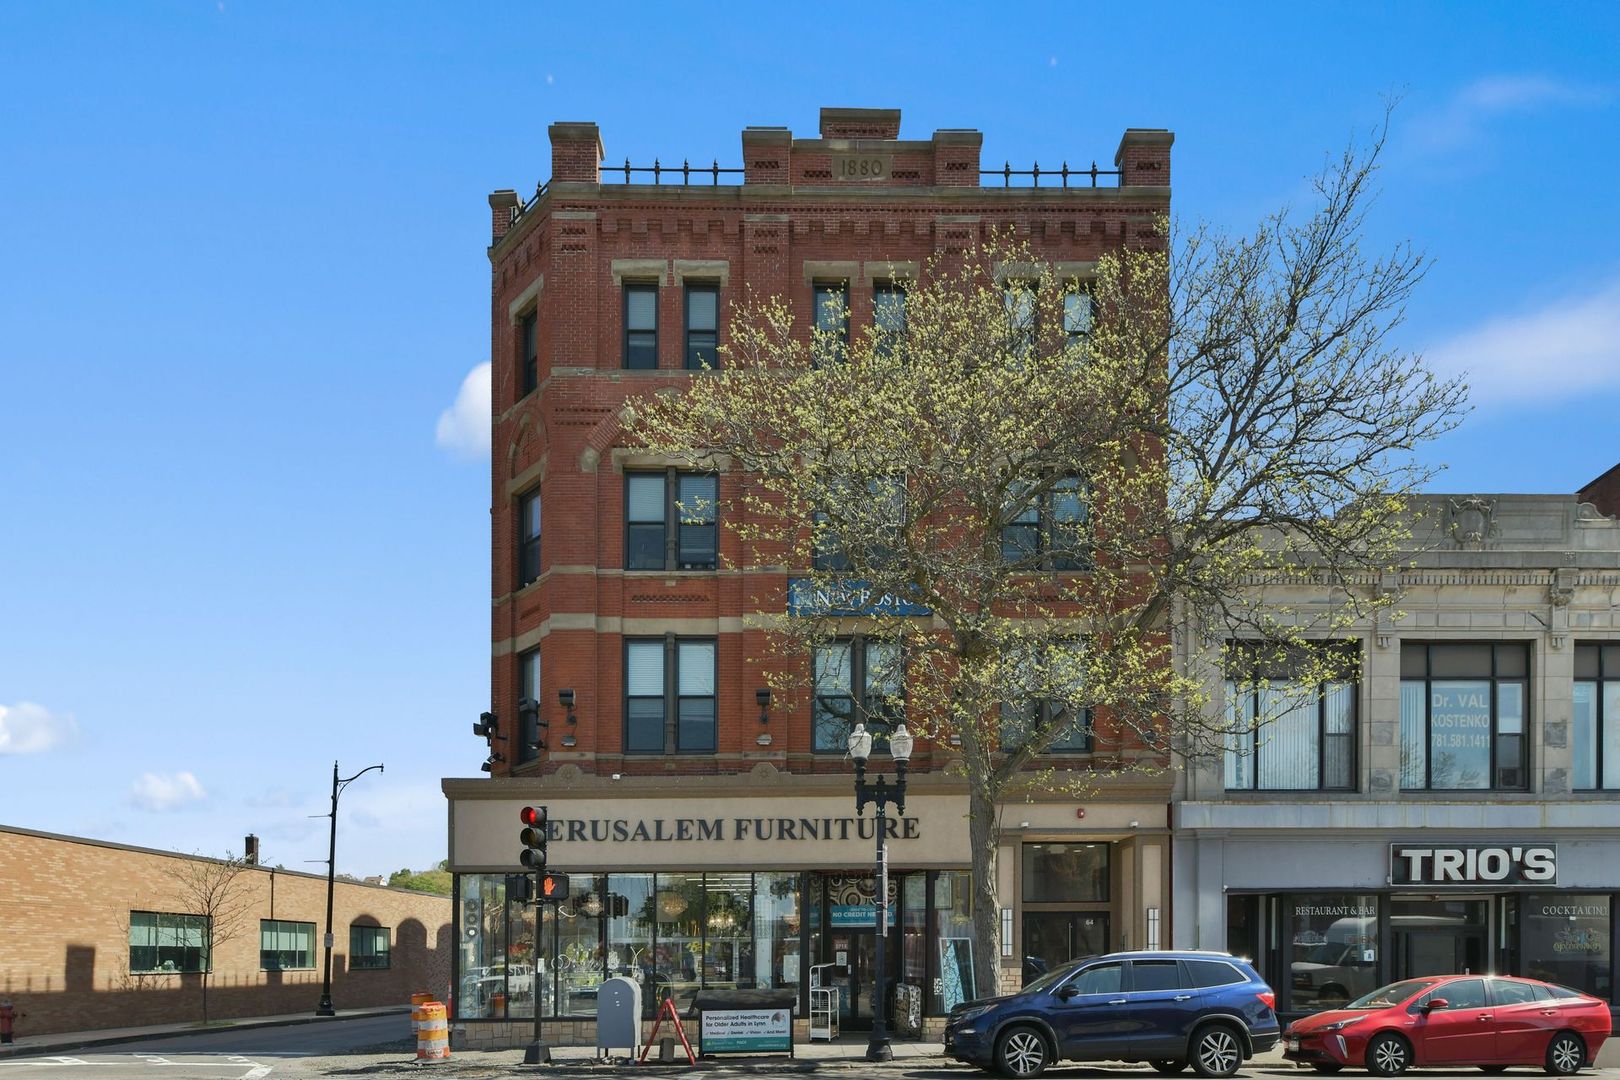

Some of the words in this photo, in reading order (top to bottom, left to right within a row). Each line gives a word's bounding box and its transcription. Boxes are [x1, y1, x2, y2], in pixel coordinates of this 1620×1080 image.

[842, 159, 883, 176] 1880
[1433, 693, 1454, 708] Dr.
[1457, 693, 1489, 708] VAL
[1431, 713, 1490, 728] KOSTENKO
[1431, 733, 1490, 748] 781.581.1411
[547, 818, 726, 842] ERUSALEM
[733, 817, 921, 841] FURNITURE
[1401, 846, 1556, 881] TRIO'S
[1295, 906, 1348, 916] RESTAURANT
[1350, 906, 1357, 915] &
[1358, 906, 1376, 915] BAR
